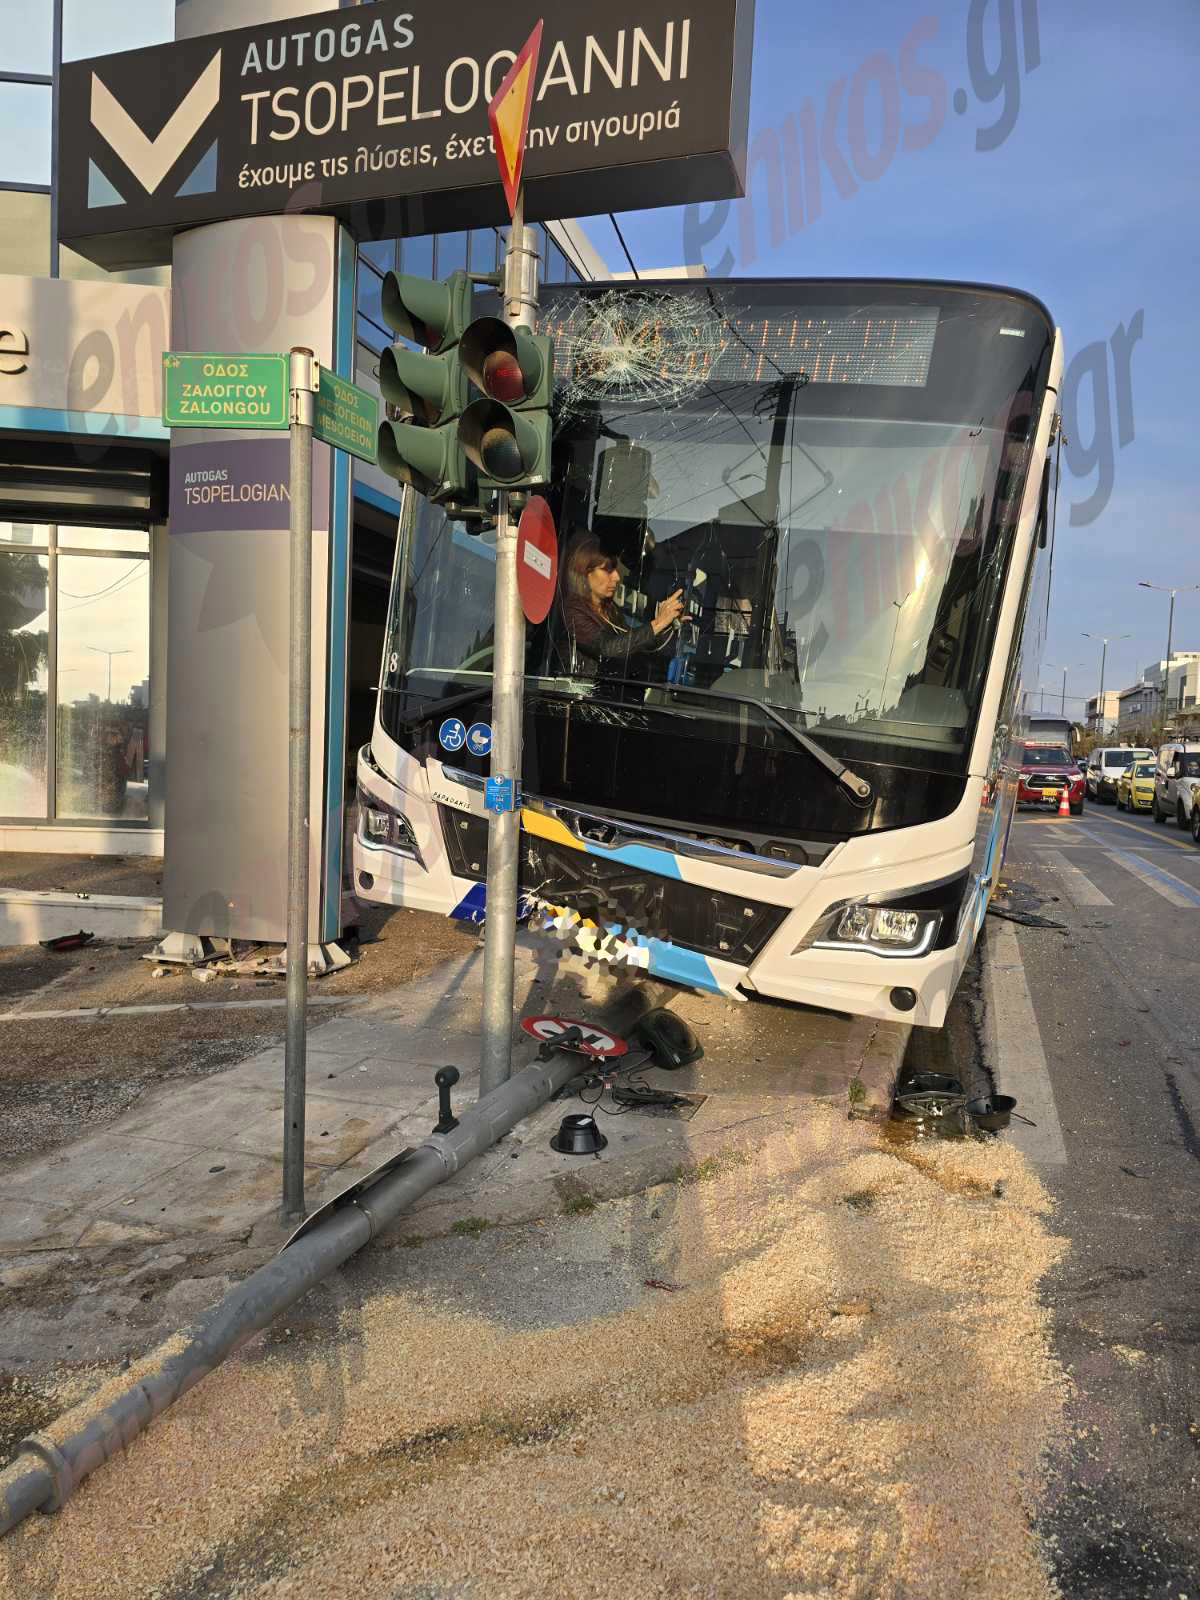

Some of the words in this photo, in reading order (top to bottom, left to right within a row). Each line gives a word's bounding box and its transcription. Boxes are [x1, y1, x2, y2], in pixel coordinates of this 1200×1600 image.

[240, 13, 415, 76] AUTOGAS
[240, 19, 690, 145] TSOPELOGANNI
[238, 161, 316, 189] έχουμε
[320, 156, 349, 177] τις
[354, 144, 438, 173] λύσεις,
[445, 132, 498, 160] έχετ
[525, 125, 560, 150] ην
[565, 100, 681, 146] σιγουριά
[202, 363, 249, 377] ΟΔΟΣ
[181, 383, 268, 398] ΖΑΛΟΓΓΟΥ
[179, 400, 271, 416] ZALONGOU
[184, 469, 228, 484] AUTOGAS
[184, 483, 291, 505] TSOPELOGIAN
